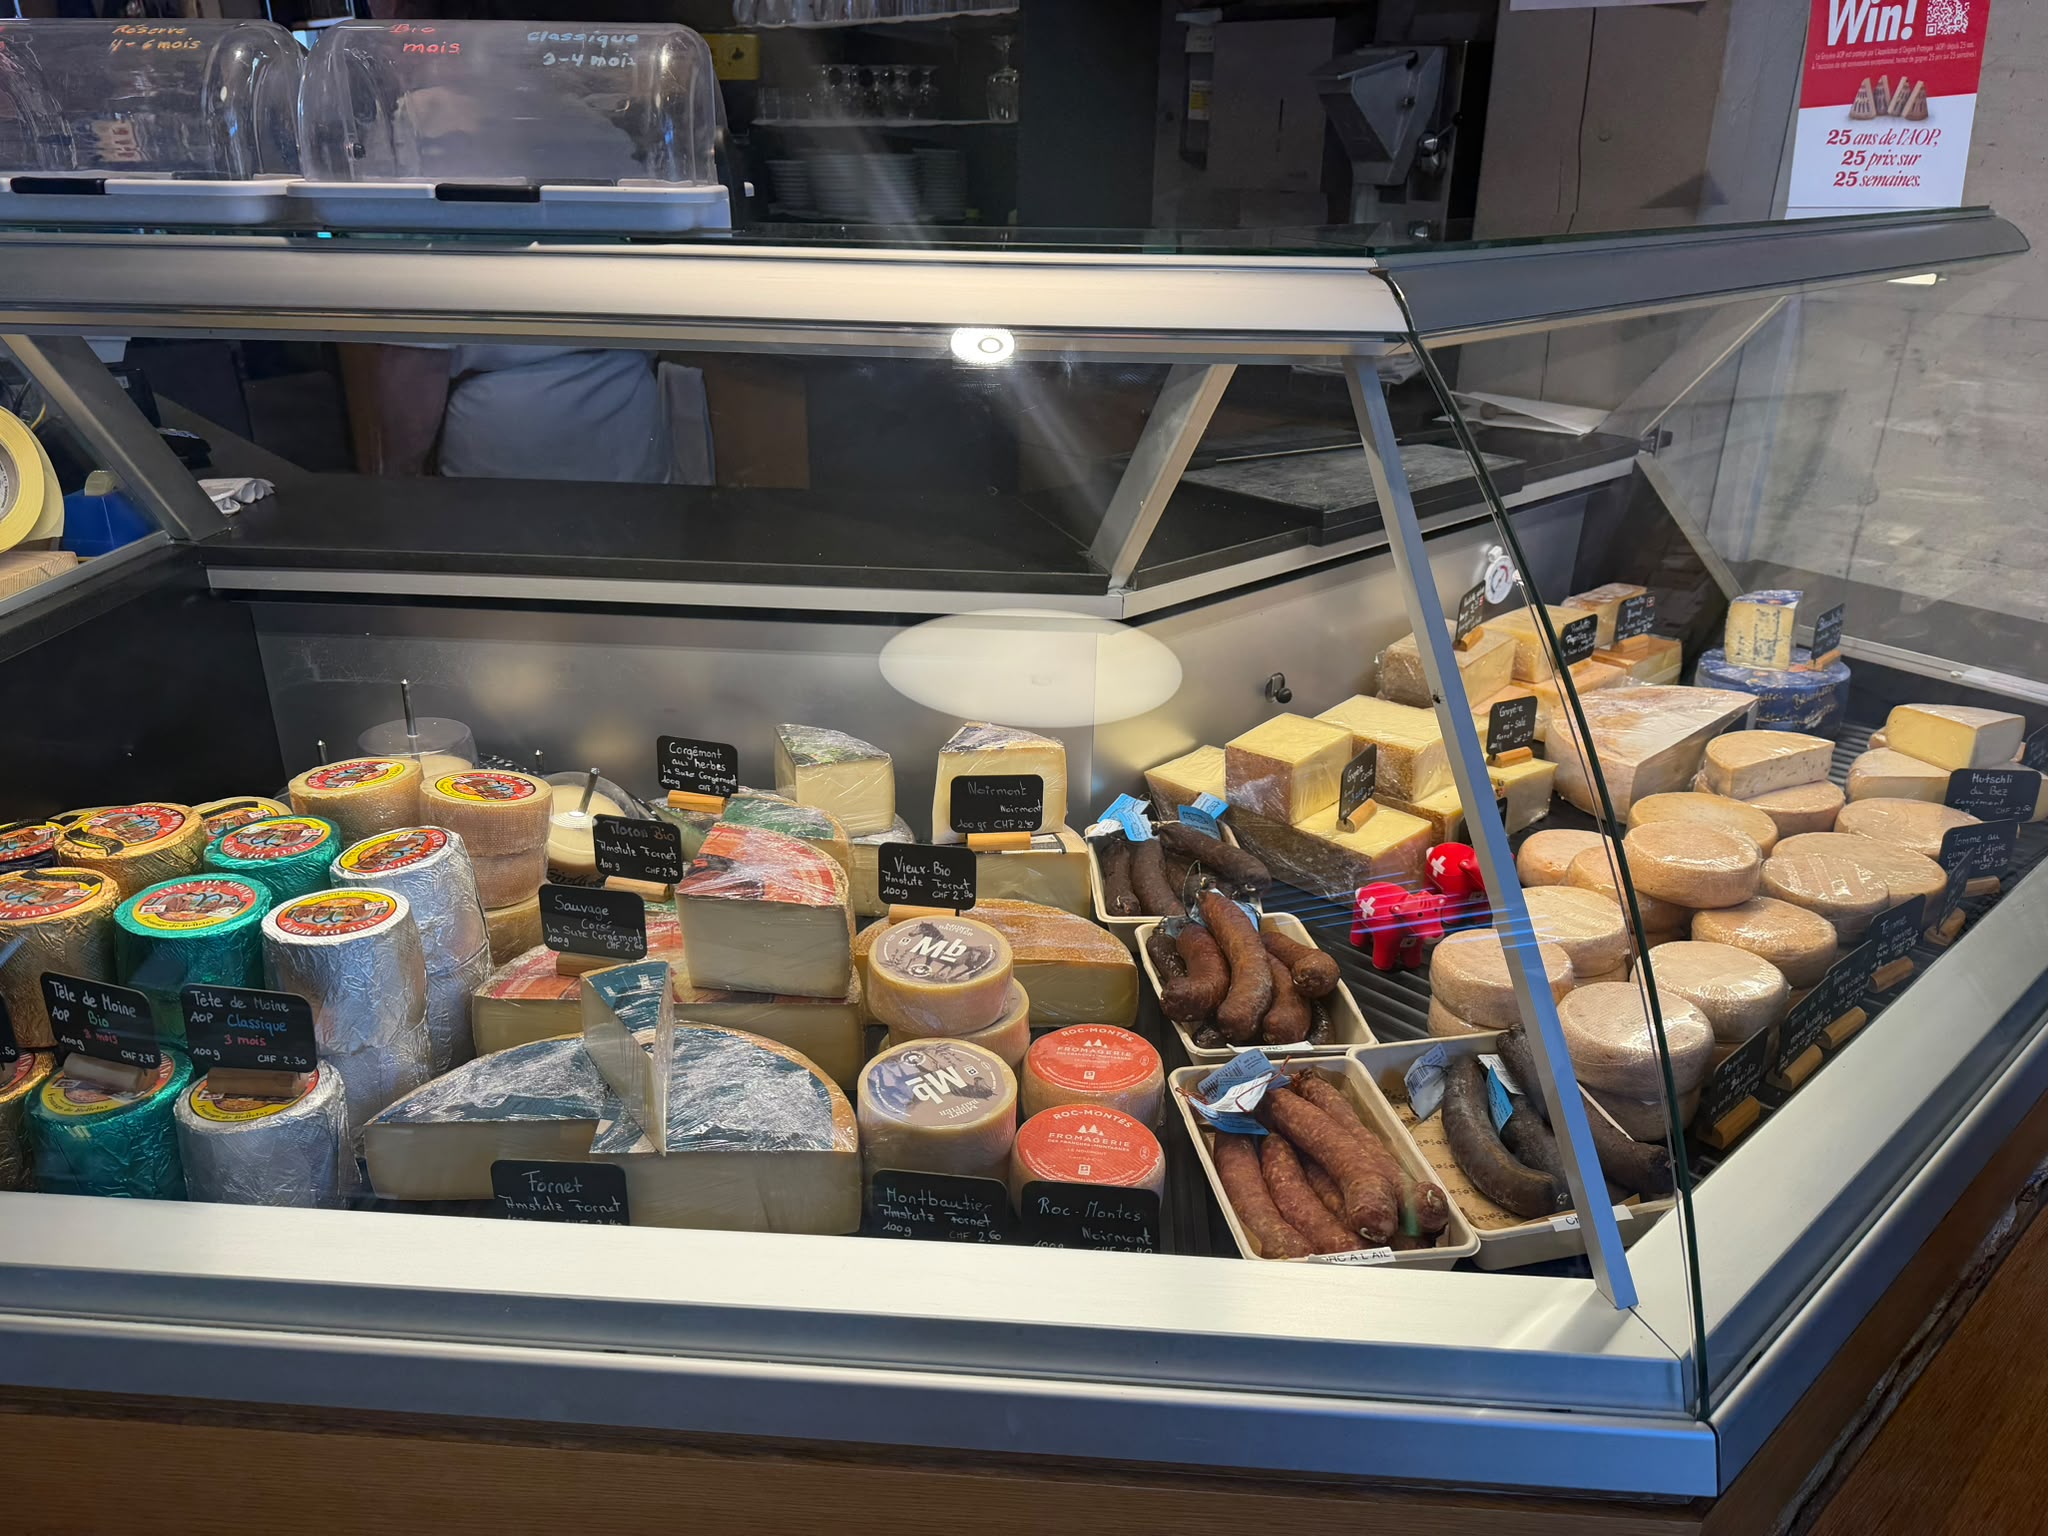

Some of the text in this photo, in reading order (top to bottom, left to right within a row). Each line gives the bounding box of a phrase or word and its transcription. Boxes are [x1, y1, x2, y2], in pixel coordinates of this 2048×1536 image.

[1827, 0, 1917, 46] Win!
[157, 37, 201, 50] mois
[403, 42, 461, 55] mois
[1826, 128, 1941, 147] 25 ans de l'AOP,
[1841, 149, 1921, 171] 25 prix sur
[1833, 170, 1920, 187] 25 semaines.
[694, 759, 726, 772] herbes
[967, 780, 1027, 796] Noirmont
[1000, 799, 1042, 813] Noirmont
[993, 820, 1015, 829] CHF
[645, 866, 660, 874] CHF
[554, 894, 610, 920] Sauvage
[606, 941, 620, 950] CHF
[909, 935, 967, 962] Mb
[82, 990, 97, 1008] de
[101, 993, 137, 1018] Moine
[190, 990, 290, 1013] Tête de Moine
[87, 1010, 109, 1028] Bio
[226, 1013, 288, 1037] Classique
[224, 1034, 267, 1047] 3 mois
[121, 1050, 137, 1061] CHF
[257, 1054, 276, 1063] CHF
[283, 1056, 307, 1065] 2.30
[1057, 1047, 1132, 1057] FROMAGERIE
[905, 1065, 967, 1104] Mb
[1048, 1132, 1131, 1147] FROMAGERIE
[521, 1170, 583, 1193] Fornet
[497, 1195, 565, 1212] Amstutz
[886, 1187, 992, 1211] Montbautier
[949, 1231, 970, 1239] CHF
[978, 1230, 1001, 1242] 2.60
[1082, 1226, 1152, 1245] Noirmont
[1372, 1250, 1390, 1259] AIL
